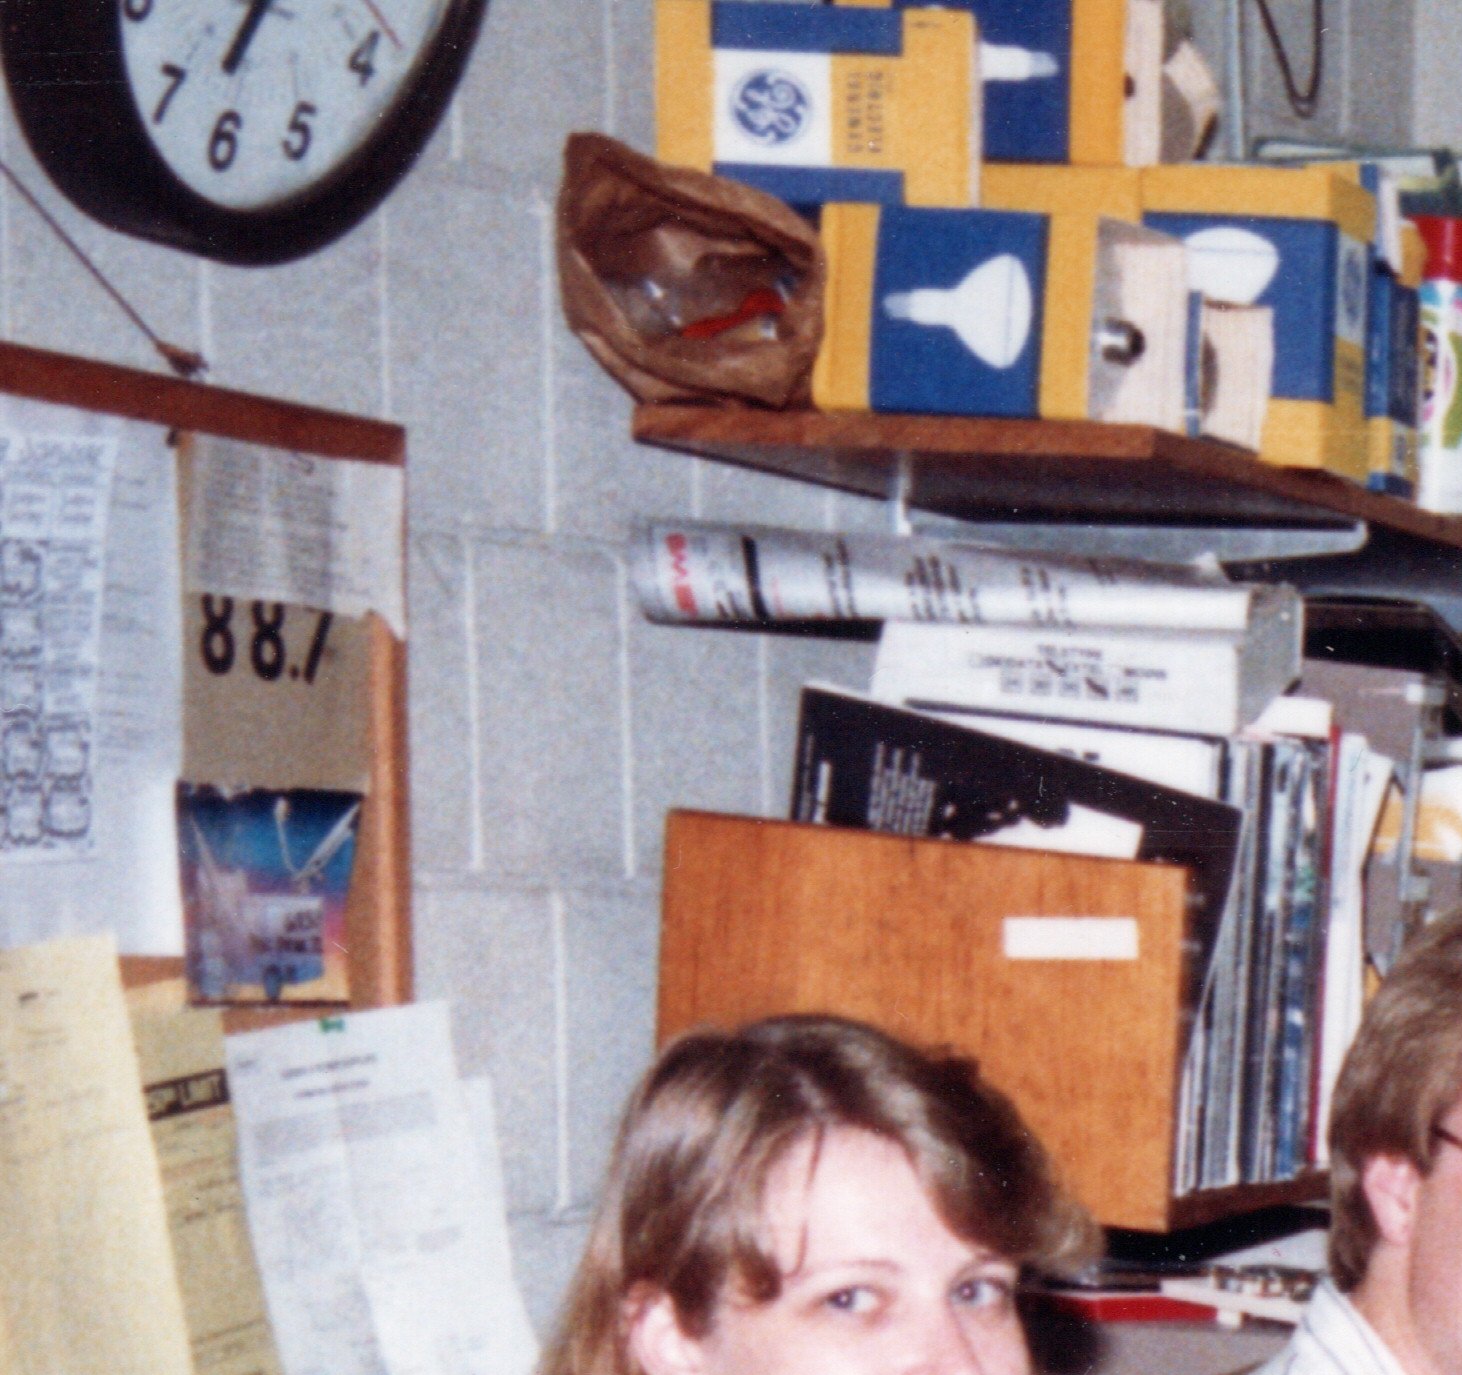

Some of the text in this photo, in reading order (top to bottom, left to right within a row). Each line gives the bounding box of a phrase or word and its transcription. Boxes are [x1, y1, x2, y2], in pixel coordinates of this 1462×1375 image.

[346, 29, 381, 88] 4
[153, 62, 187, 125] 7
[207, 110, 243, 173] 6
[282, 100, 317, 162] 5
